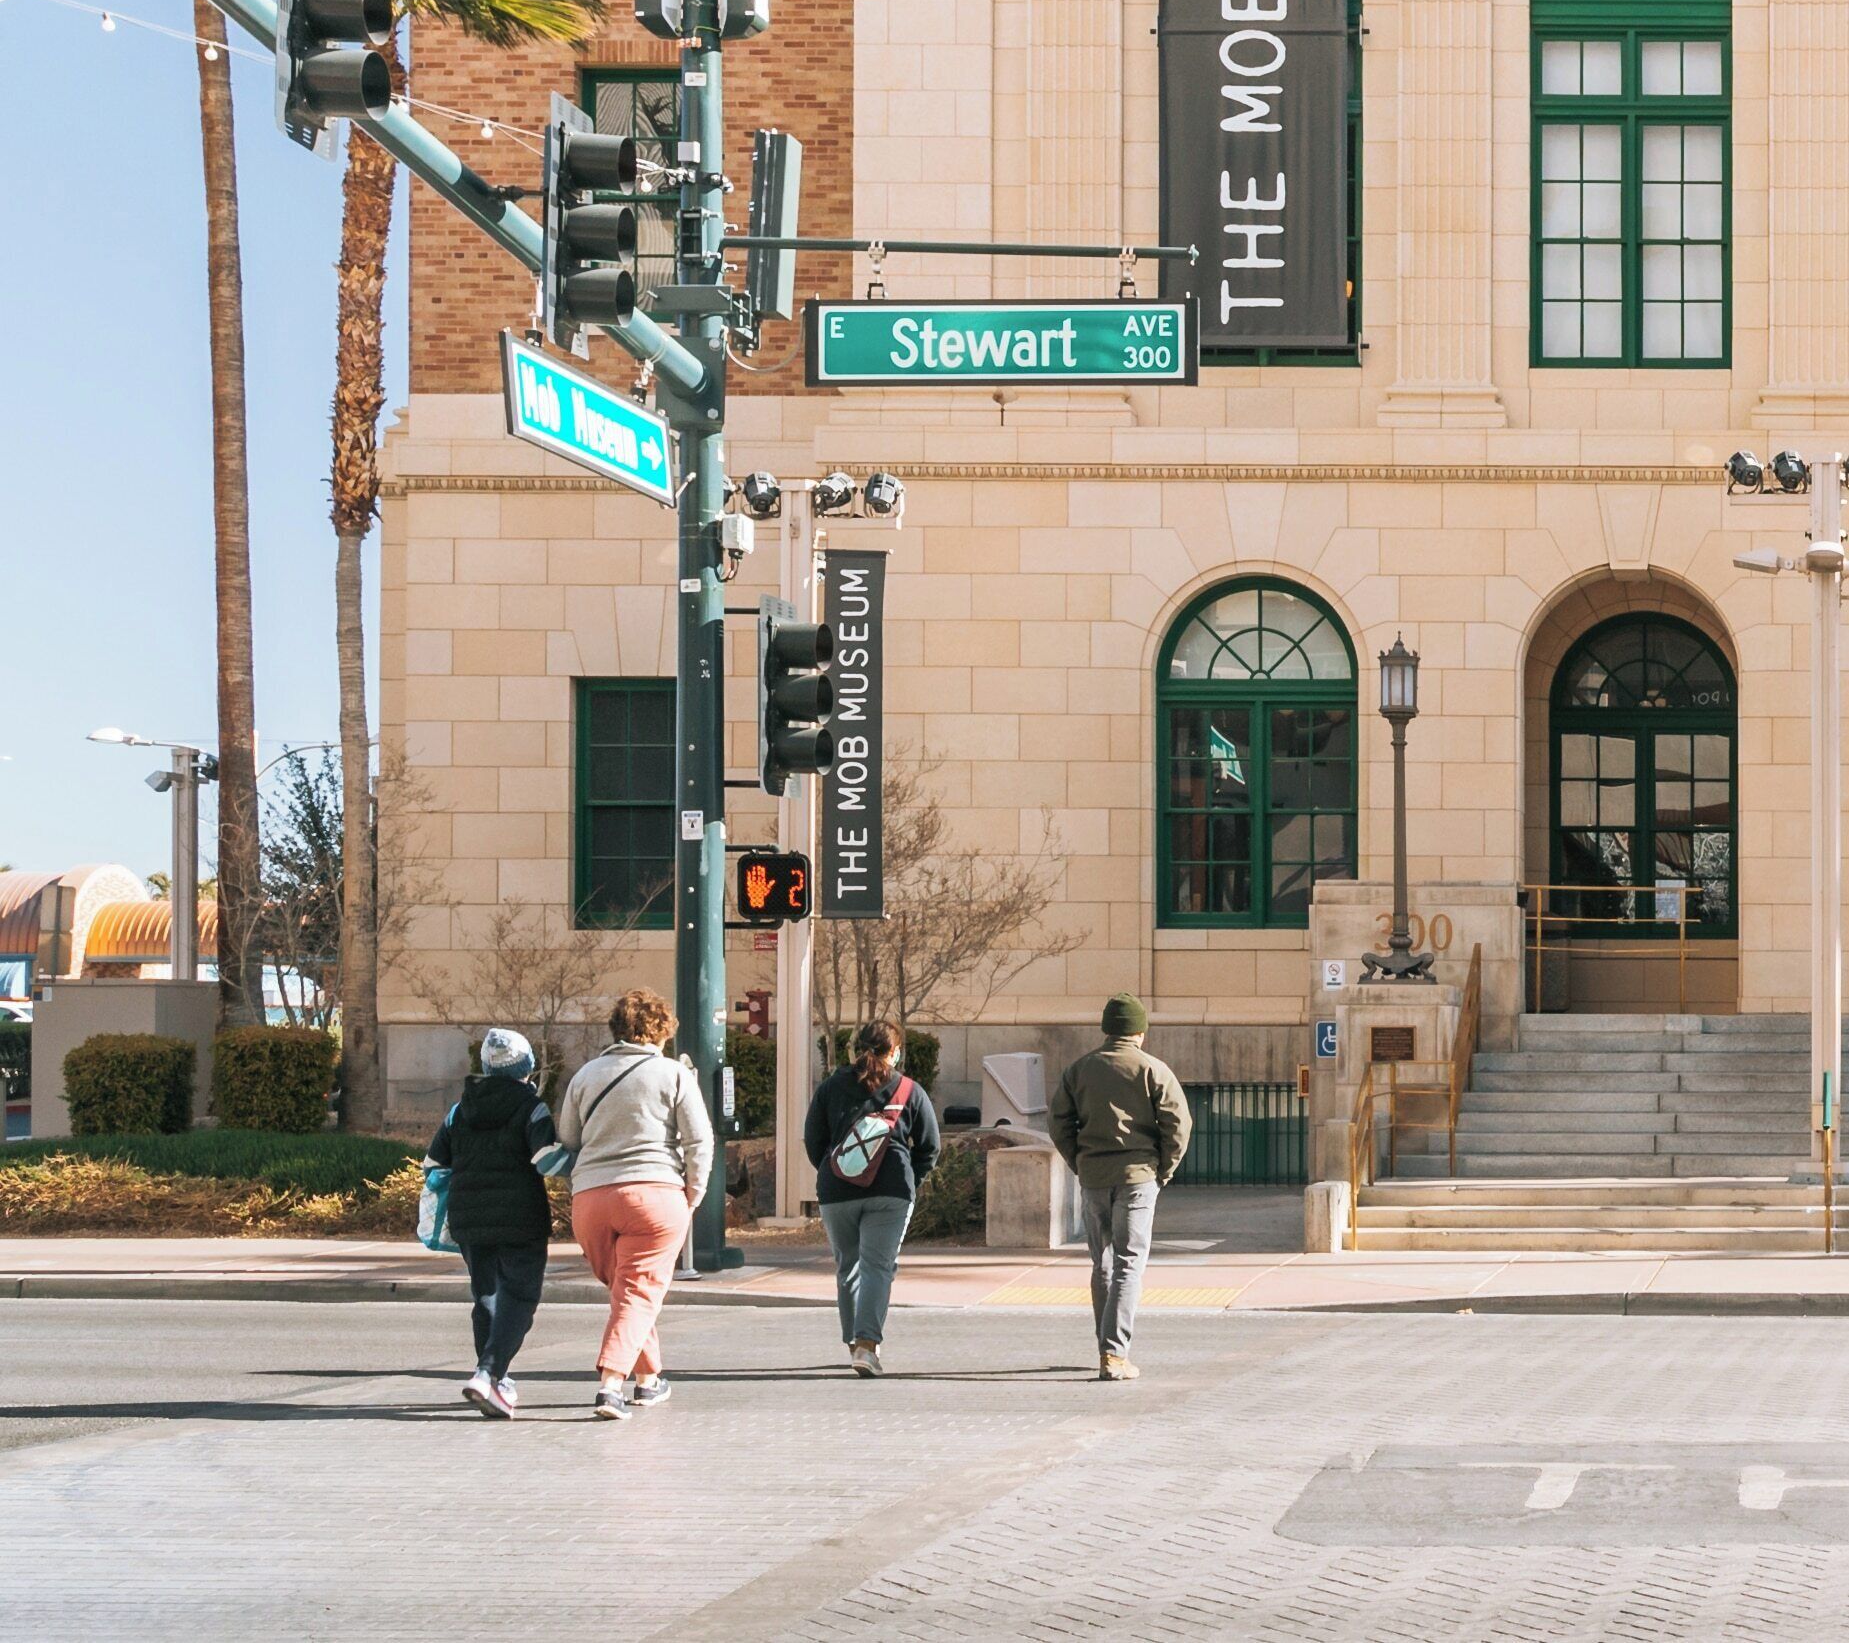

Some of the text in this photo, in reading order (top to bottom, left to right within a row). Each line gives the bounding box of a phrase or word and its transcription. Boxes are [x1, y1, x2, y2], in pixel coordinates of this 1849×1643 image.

[1219, 170, 1286, 326] THE
[830, 314, 1173, 369] E Stewart AVE
[1123, 345, 1171, 369] 300
[520, 361, 561, 433] Mob
[837, 568, 870, 900] THE MOB MUSEUM
[789, 868, 805, 907] 2
